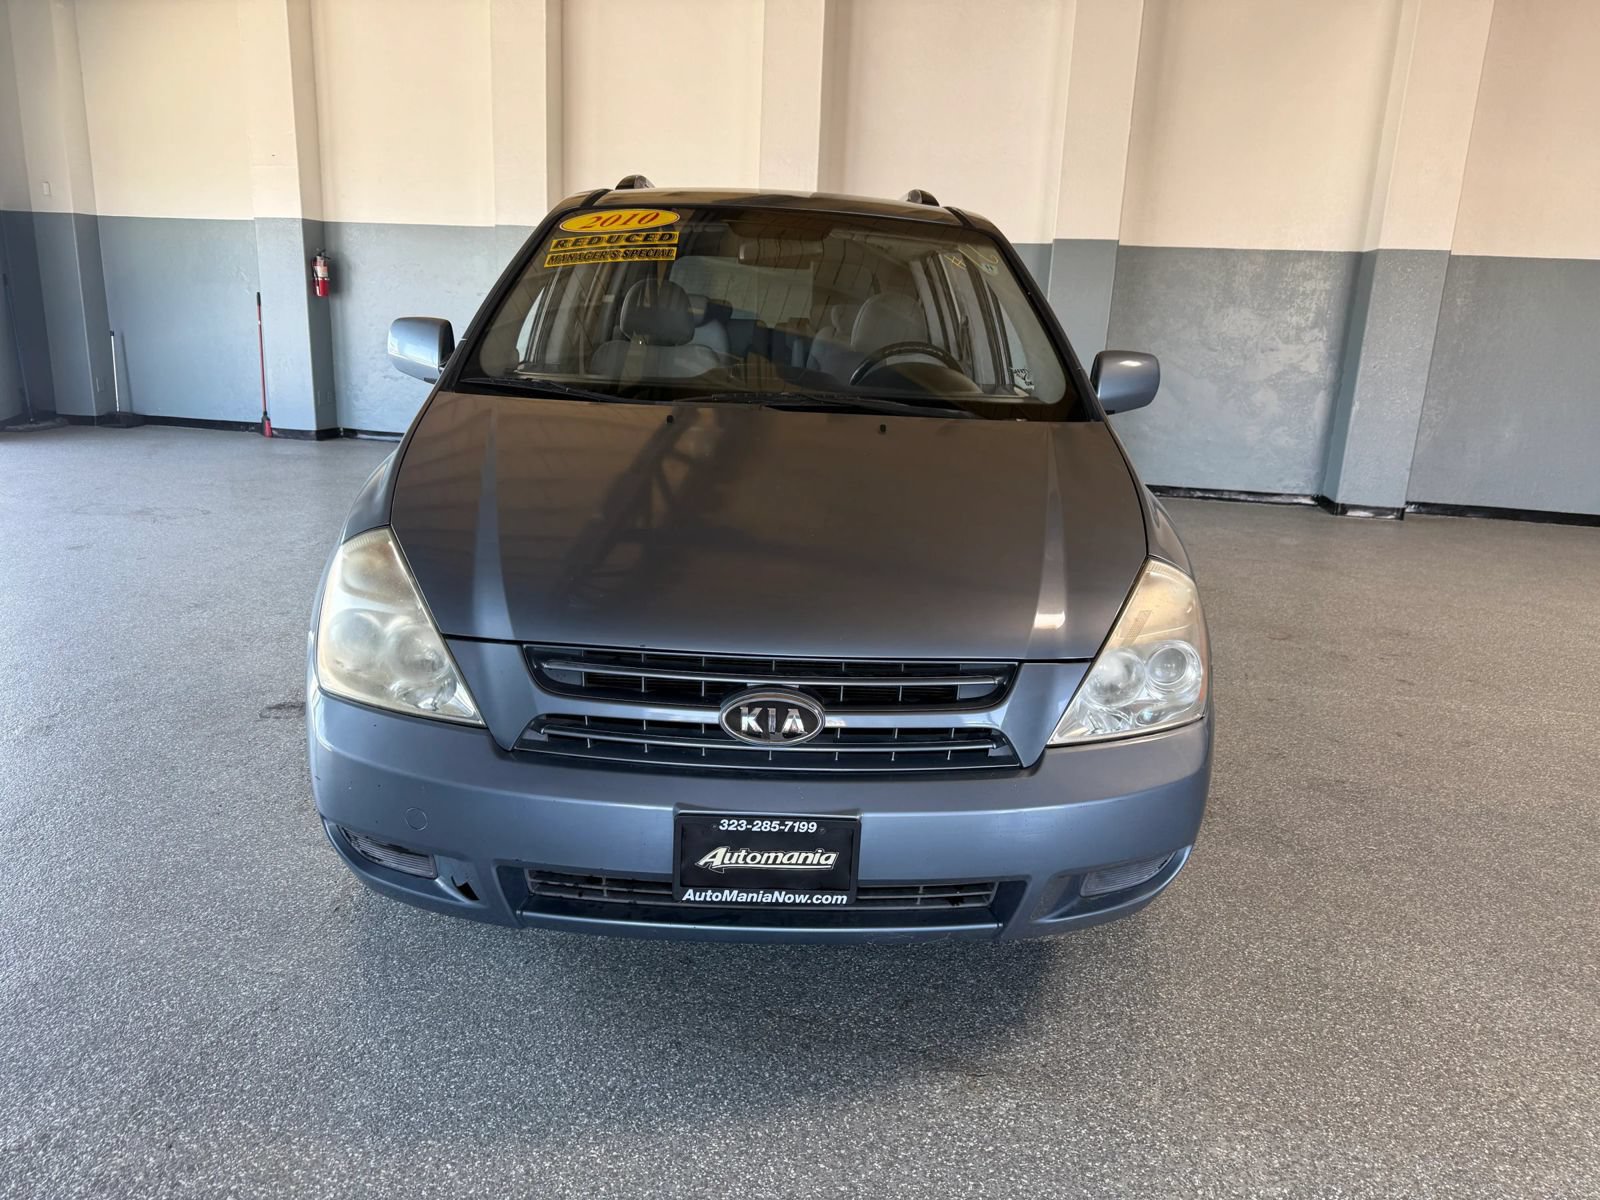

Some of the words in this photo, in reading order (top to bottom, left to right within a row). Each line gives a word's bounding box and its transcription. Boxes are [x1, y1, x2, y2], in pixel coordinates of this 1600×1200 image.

[578, 211, 660, 229] 2010
[552, 232, 674, 249] REDUCED
[622, 248, 675, 260] SPECIAL
[740, 706, 808, 735] KIA
[719, 819, 817, 833] 323-285-7199
[696, 847, 839, 870] Automania
[682, 888, 848, 905] AutoManiaNow.com
